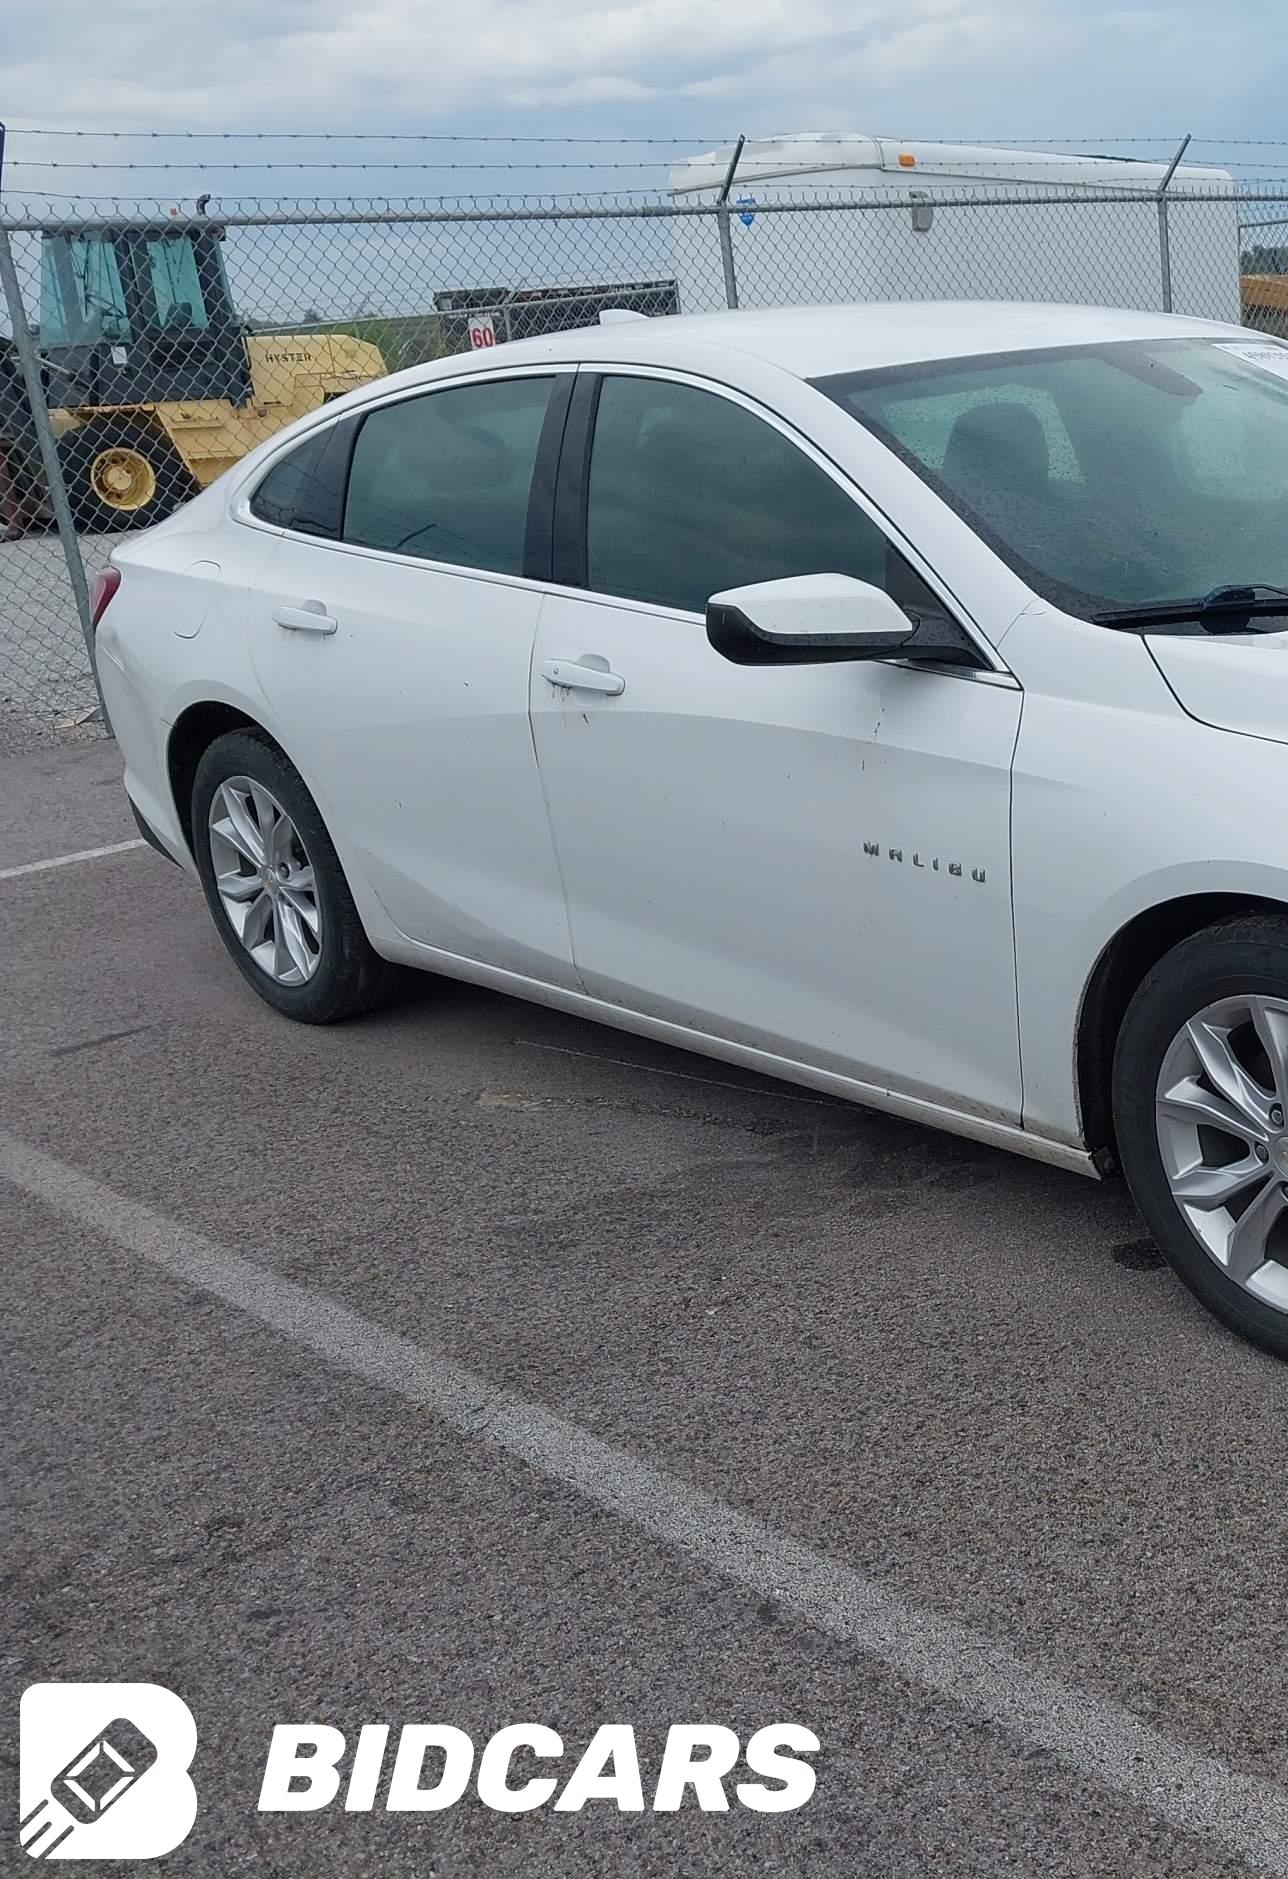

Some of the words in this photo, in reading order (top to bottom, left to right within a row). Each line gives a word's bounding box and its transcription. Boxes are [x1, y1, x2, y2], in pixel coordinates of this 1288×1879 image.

[471, 327, 493, 349] 60
[265, 352, 313, 364] HYSTER
[863, 840, 986, 883] MALIBU
